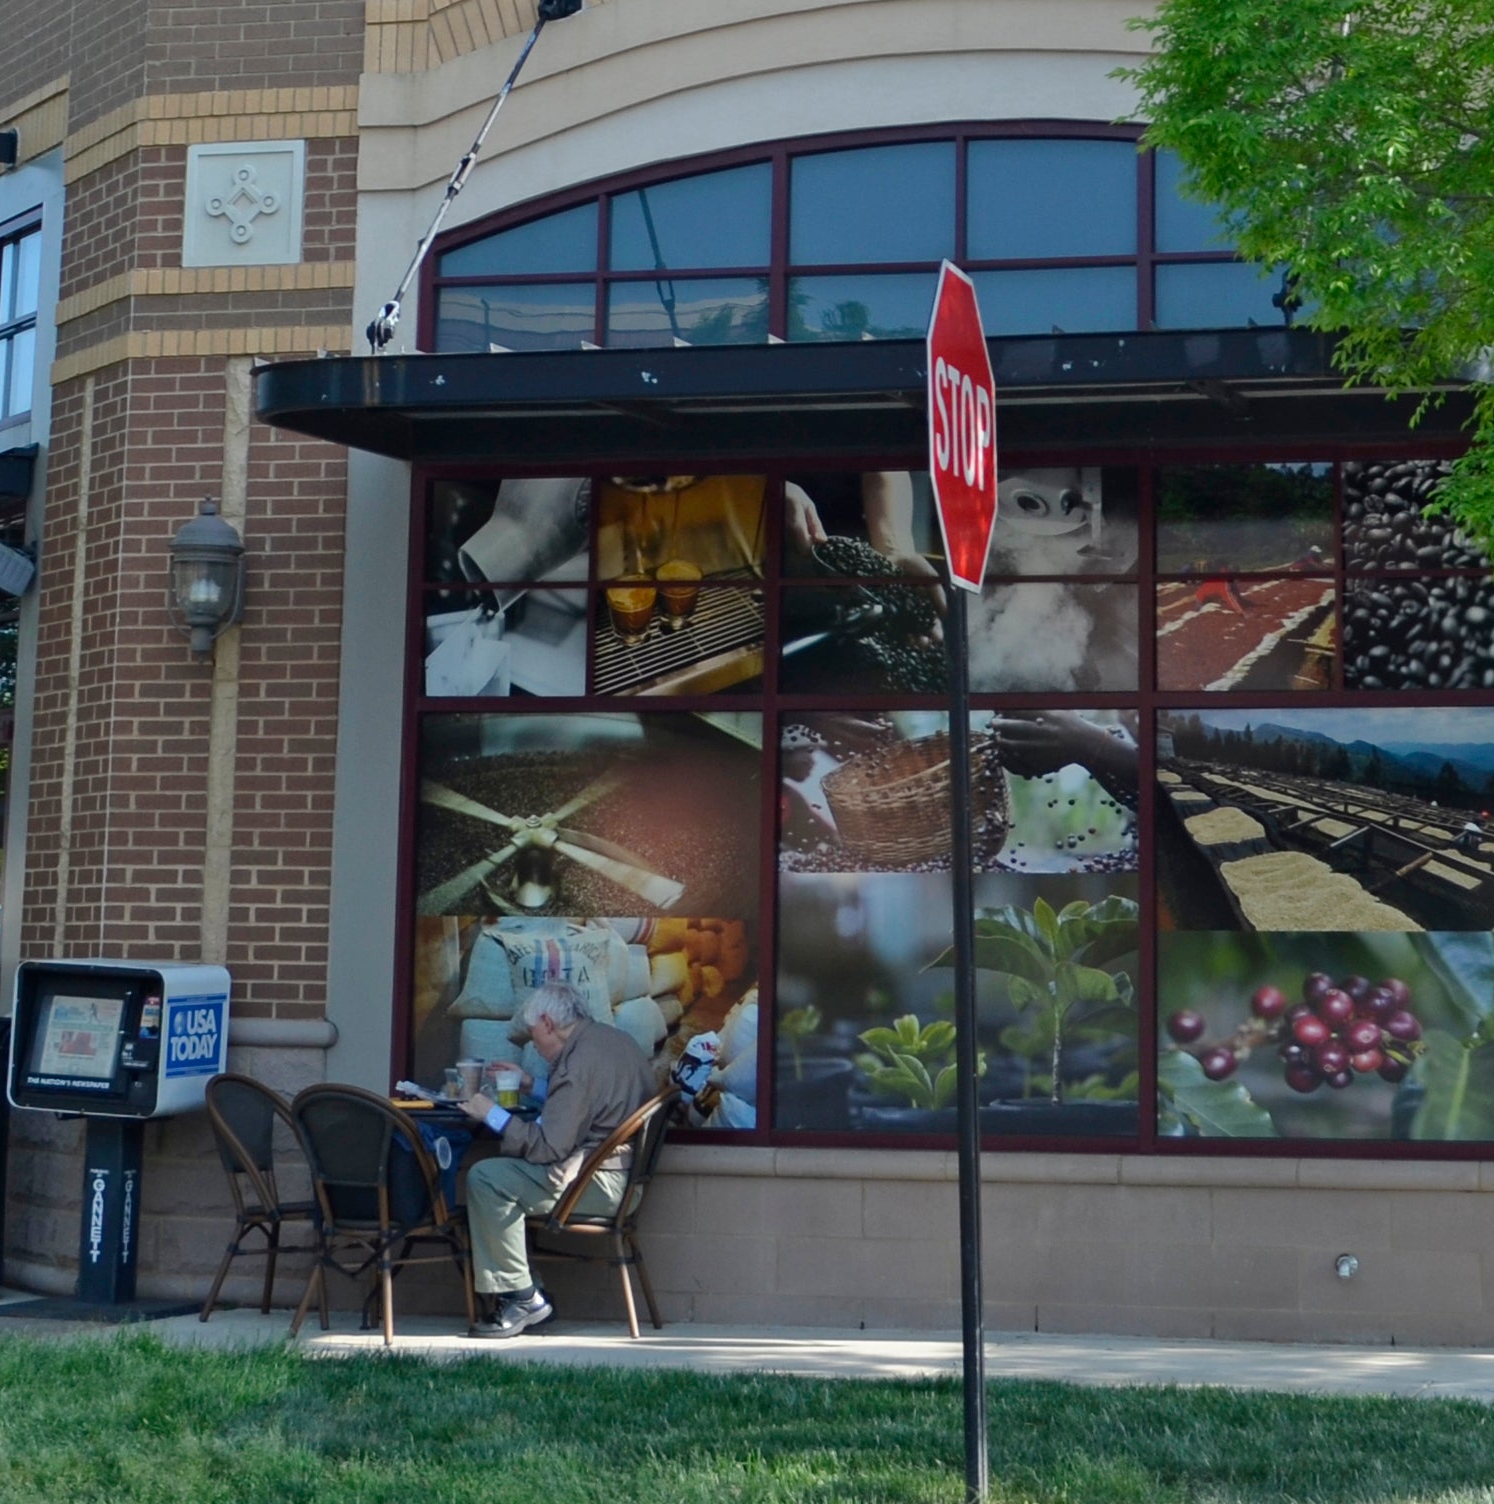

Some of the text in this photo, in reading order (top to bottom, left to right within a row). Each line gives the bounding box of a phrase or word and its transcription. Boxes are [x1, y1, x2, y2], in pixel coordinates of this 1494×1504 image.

[935, 356, 990, 491] STOP
[170, 1034, 218, 1062] TODAY
[187, 1008, 217, 1035] USA
[89, 1178, 105, 1263] GANNETT
[122, 1180, 133, 1263] GANNETT
